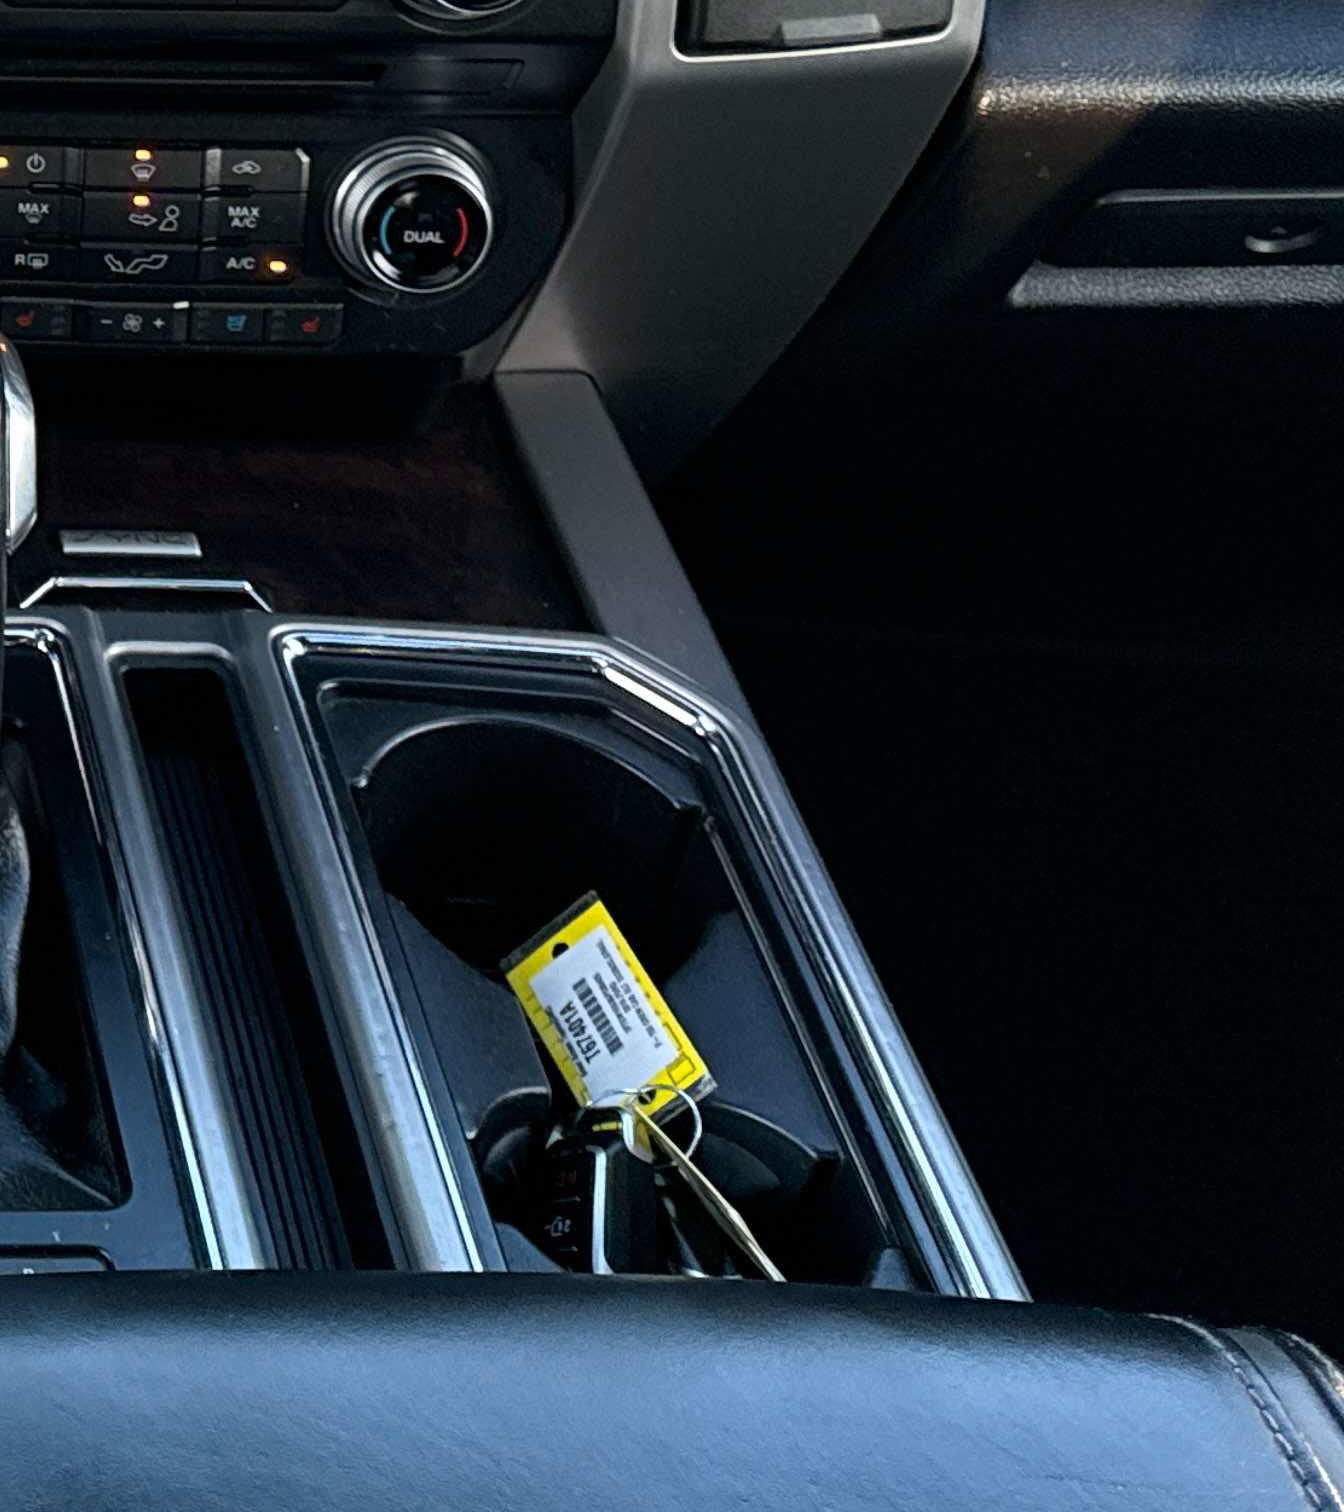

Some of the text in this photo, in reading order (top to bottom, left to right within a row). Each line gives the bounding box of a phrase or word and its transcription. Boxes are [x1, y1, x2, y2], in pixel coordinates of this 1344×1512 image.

[17, 202, 50, 215] MAX
[227, 205, 260, 218] MAX
[230, 217, 257, 229] A/C
[403, 230, 445, 244] DUAL
[14, 253, 26, 266] R
[225, 258, 255, 270] A/C
[559, 999, 602, 1065] T67401A
